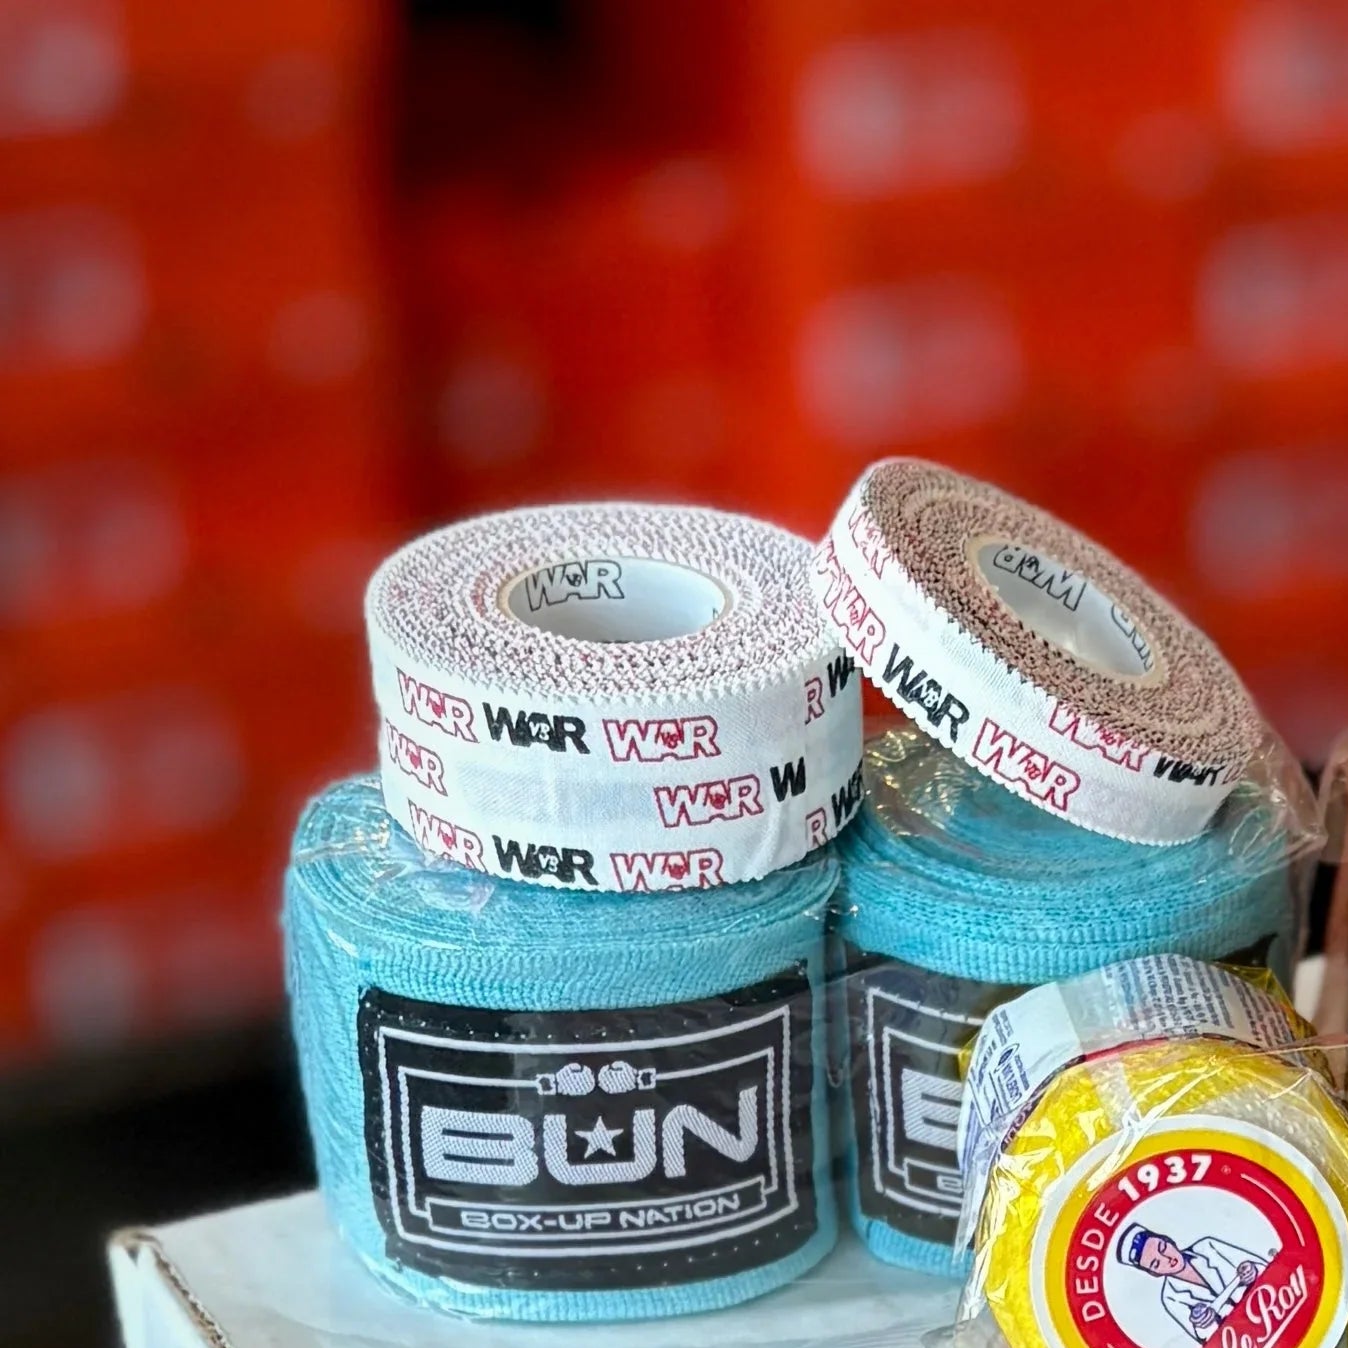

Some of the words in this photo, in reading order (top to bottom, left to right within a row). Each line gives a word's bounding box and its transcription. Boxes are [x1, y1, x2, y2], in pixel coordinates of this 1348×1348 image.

[396, 667, 479, 744] WAR
[482, 702, 591, 755] WAR
[602, 715, 721, 762] WAR
[882, 642, 971, 744] WAR
[972, 717, 1081, 812] WAR
[407, 800, 488, 873] WAR
[492, 835, 599, 888] WAR
[611, 847, 724, 892] WAR
[654, 774, 764, 829] WAR
[459, 1210, 612, 1233] BOX-UP
[619, 1193, 742, 1229] NATION
[1075, 1201, 1121, 1324] DESDE
[1116, 1154, 1214, 1203] 1937
